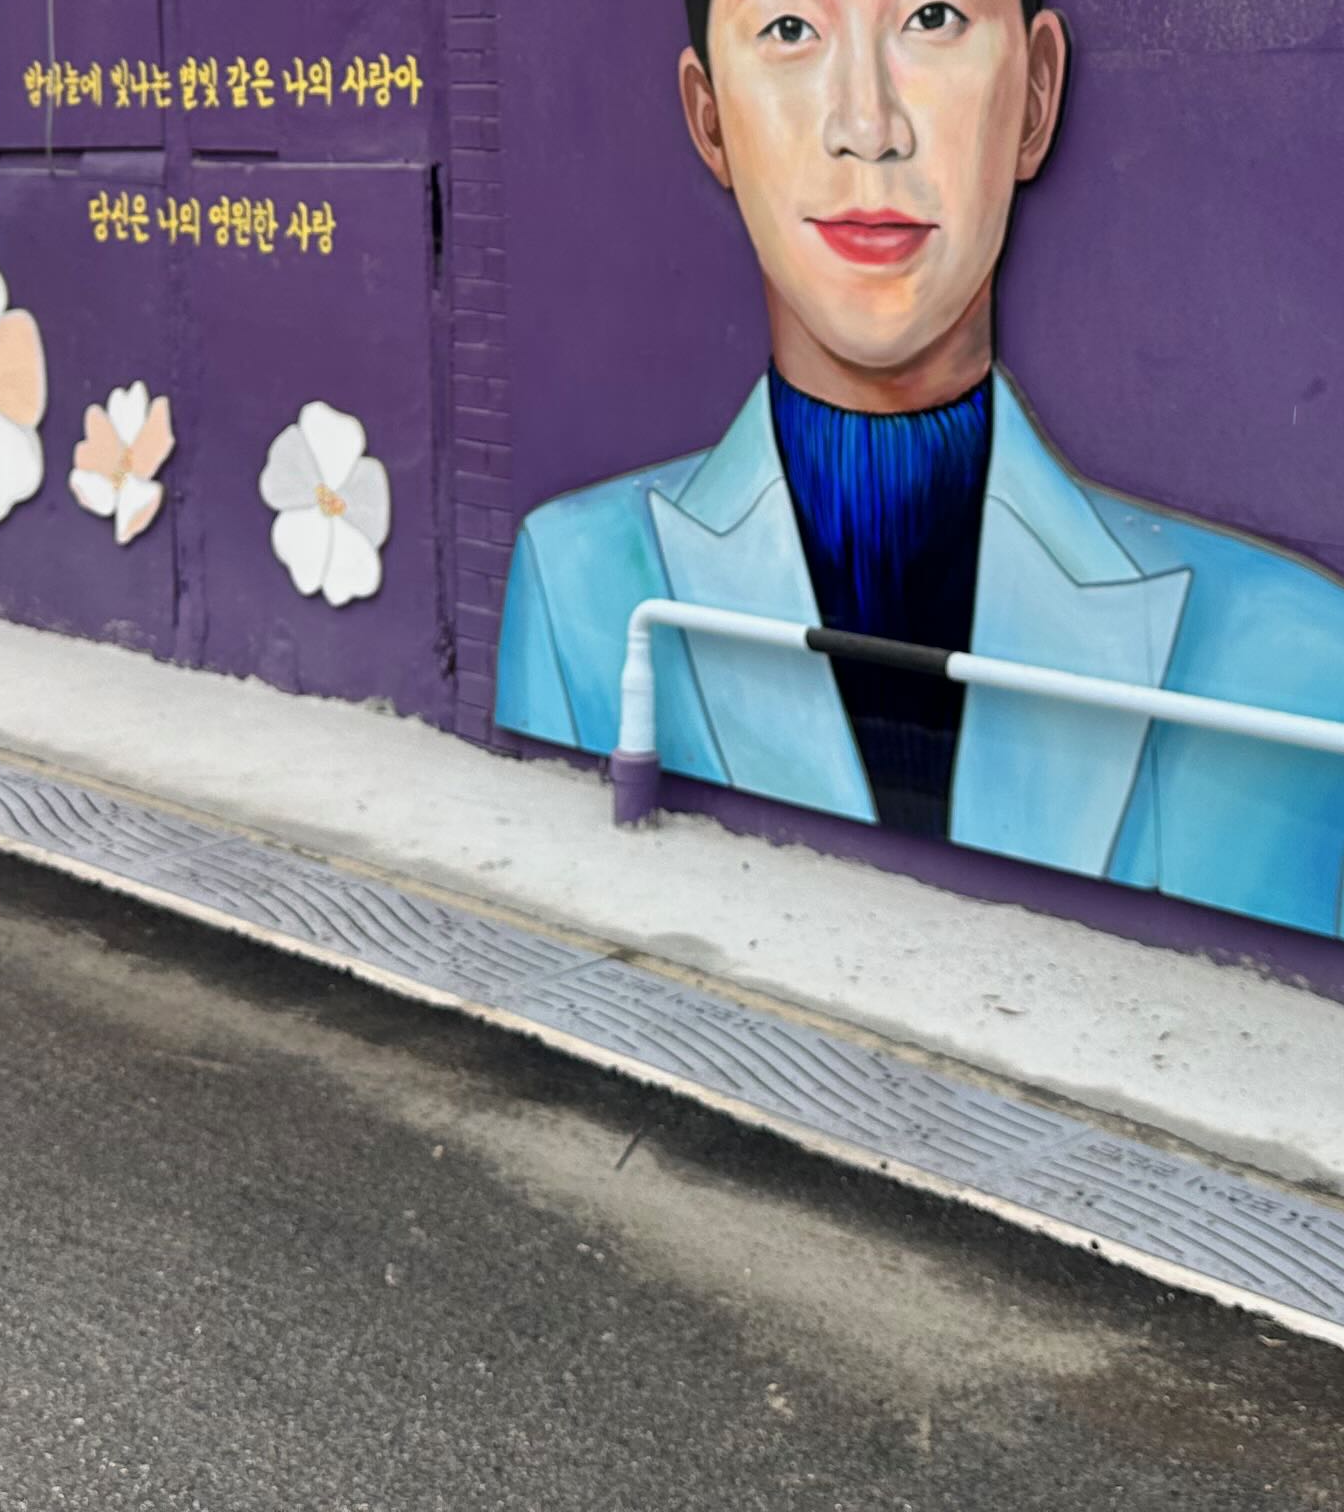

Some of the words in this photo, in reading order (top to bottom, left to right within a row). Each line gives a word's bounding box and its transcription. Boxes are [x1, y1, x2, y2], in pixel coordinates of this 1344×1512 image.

[22, 60, 104, 109] 밤하늘에
[109, 58, 174, 109] 빛나는
[177, 55, 220, 112] 별빛
[225, 55, 276, 110] 같은
[281, 56, 334, 107] 나의
[339, 53, 425, 109] 사랑아
[87, 190, 151, 244] 당신은
[155, 197, 202, 247] 나의
[206, 195, 280, 255] 영원한
[284, 200, 337, 255] 사랑
